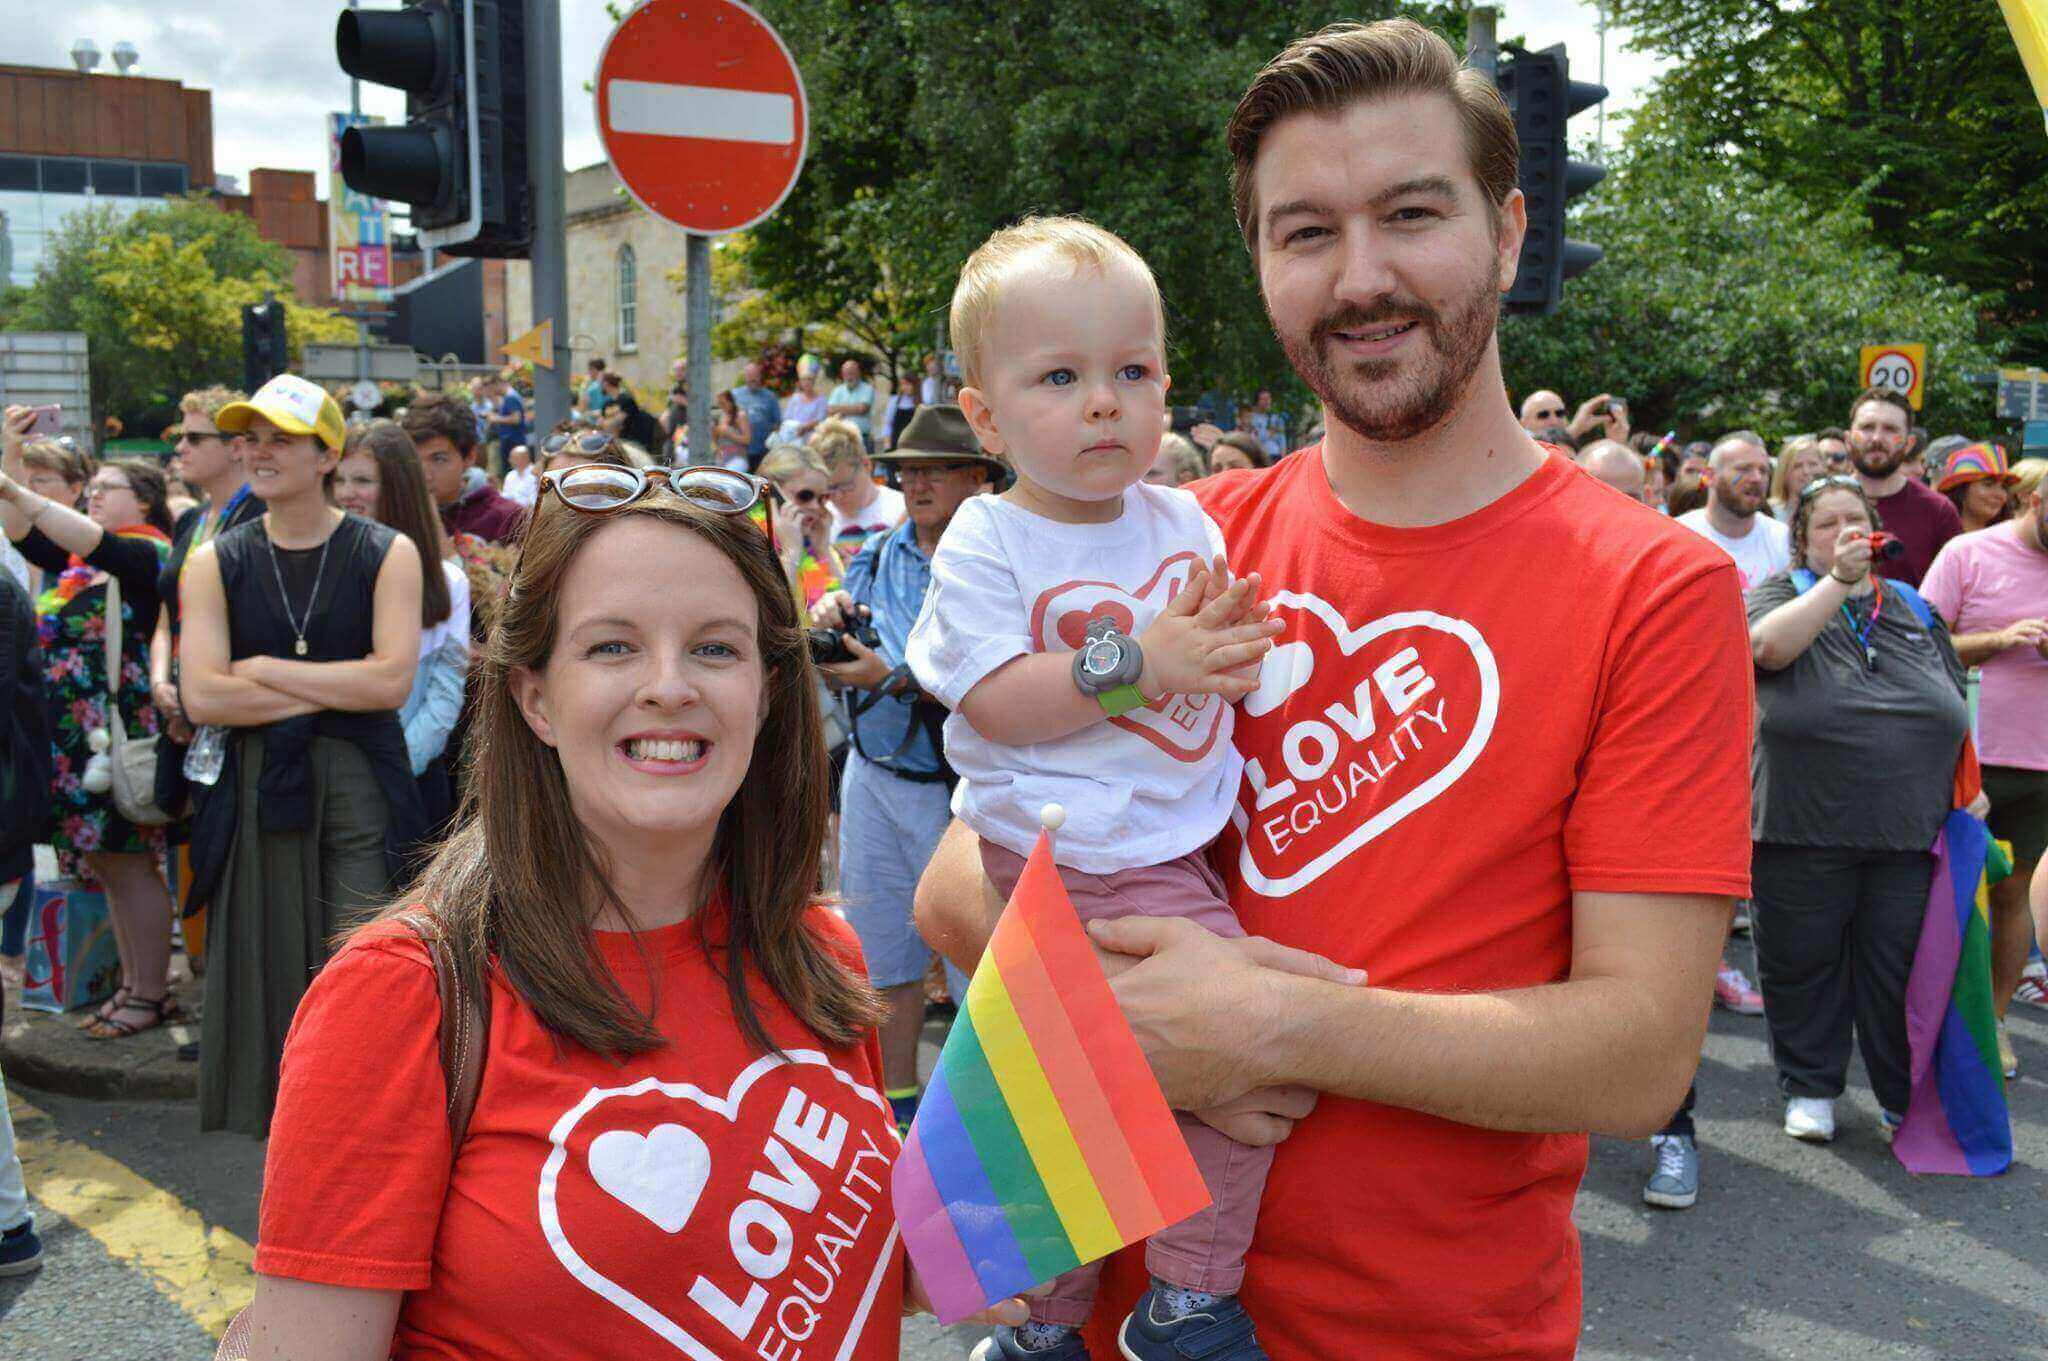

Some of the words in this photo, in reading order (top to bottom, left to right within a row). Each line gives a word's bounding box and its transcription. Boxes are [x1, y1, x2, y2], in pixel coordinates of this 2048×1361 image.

[1874, 366, 1910, 388] 20
[1245, 646, 1436, 812] LOVE
[1262, 697, 1448, 856] EQUALITY
[687, 1086, 849, 1341] LOVE
[757, 1128, 891, 1361] EQUALITY
